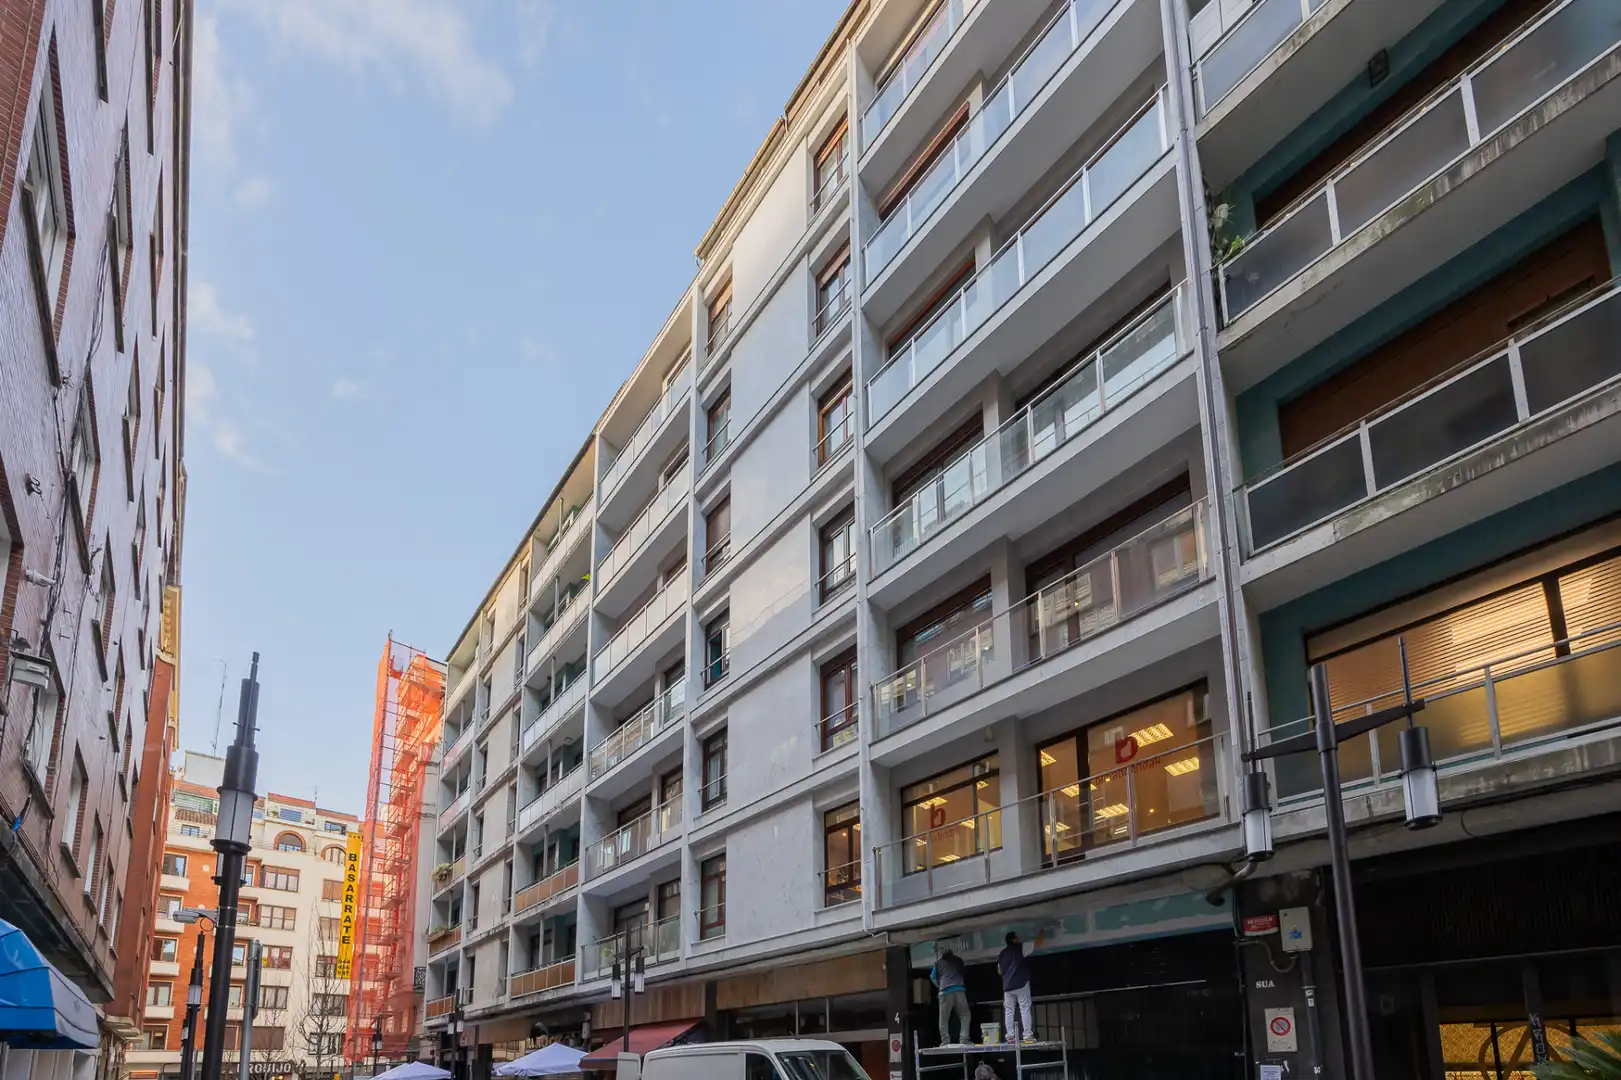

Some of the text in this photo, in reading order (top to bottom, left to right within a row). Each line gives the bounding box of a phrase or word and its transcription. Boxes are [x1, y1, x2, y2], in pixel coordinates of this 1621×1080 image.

[341, 853, 357, 945] BASARRATE
[1255, 980, 1275, 989] SUA
[894, 1012, 900, 1024] 4
